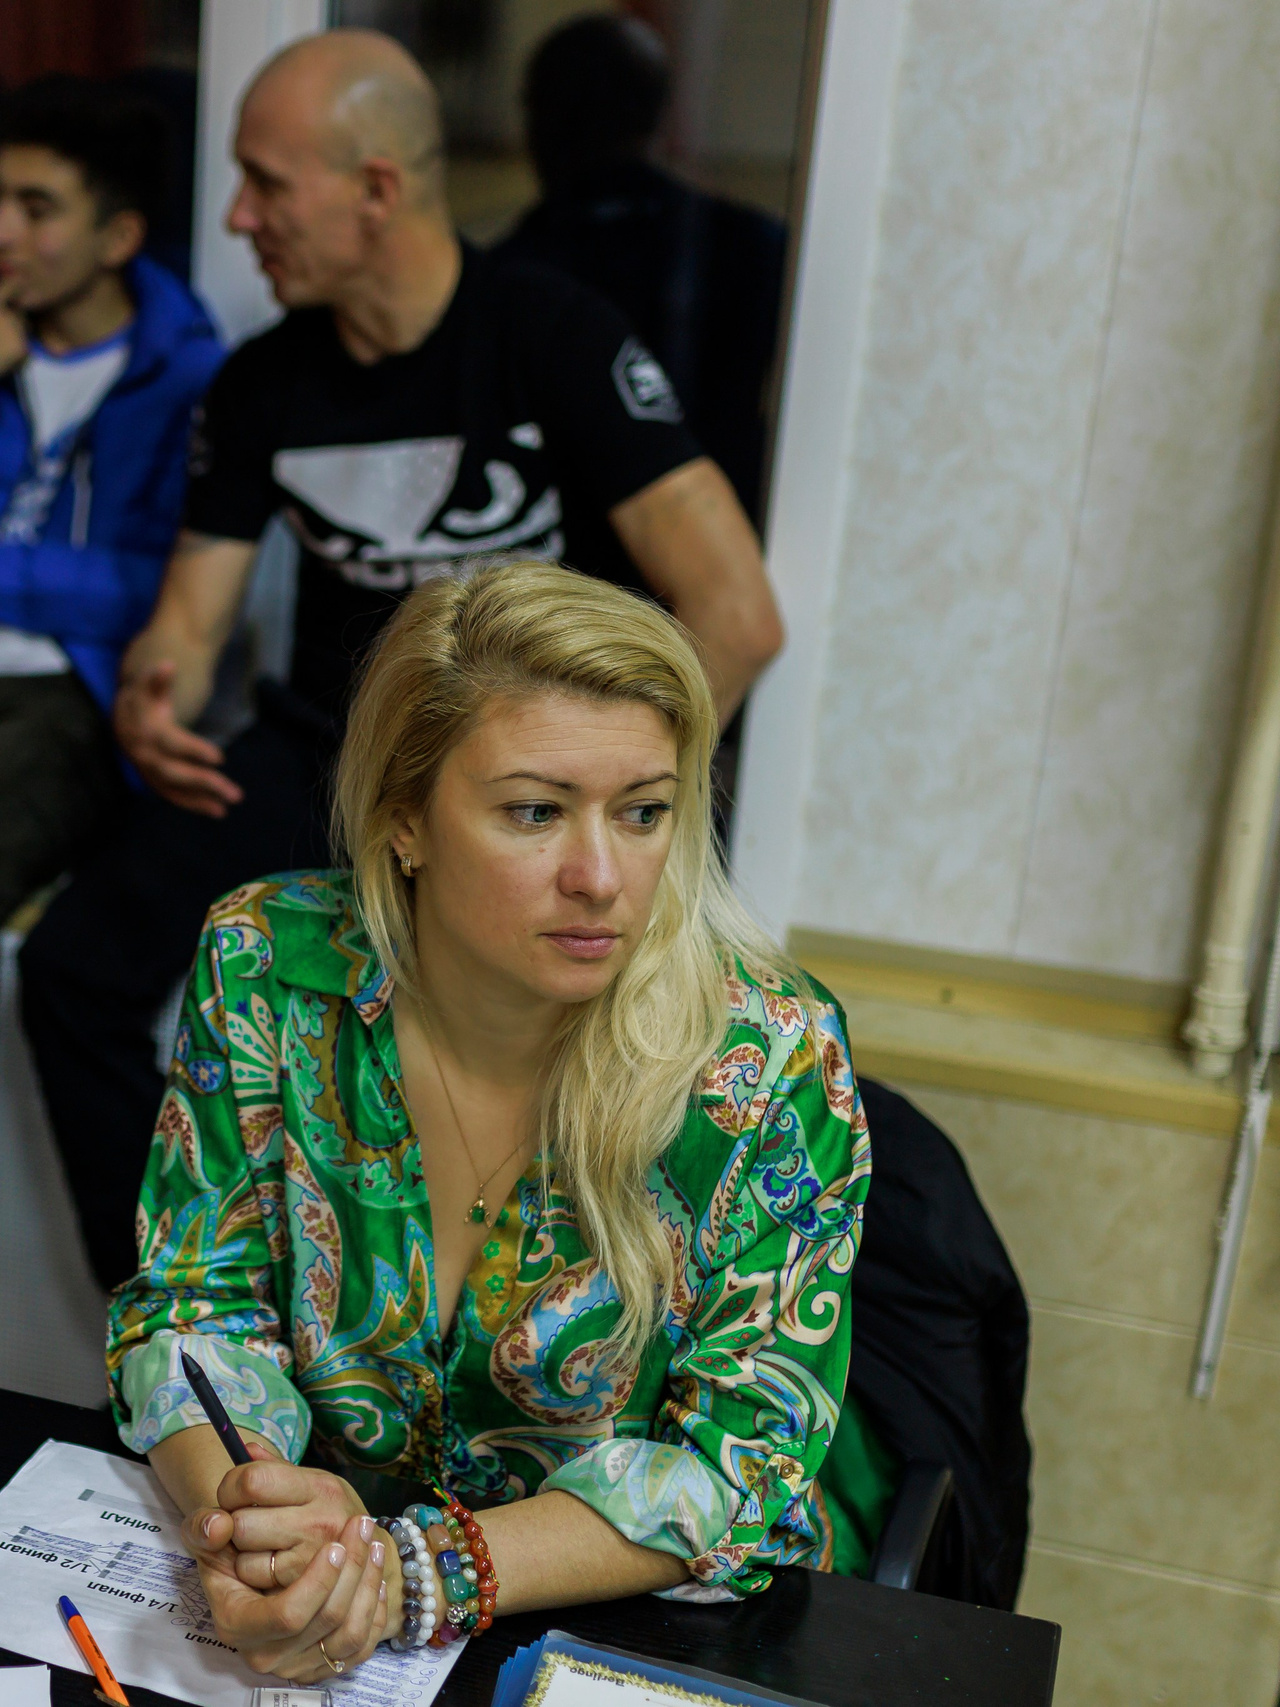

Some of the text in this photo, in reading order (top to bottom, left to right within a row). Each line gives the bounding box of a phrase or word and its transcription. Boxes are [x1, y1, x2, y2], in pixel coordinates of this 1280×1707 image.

[100, 1510, 162, 1534] ФИНАЛ
[60, 1557, 93, 1574] 1/2
[87, 1581, 179, 1613] 1/4 финал
[569, 1667, 625, 1688] Berlingo
